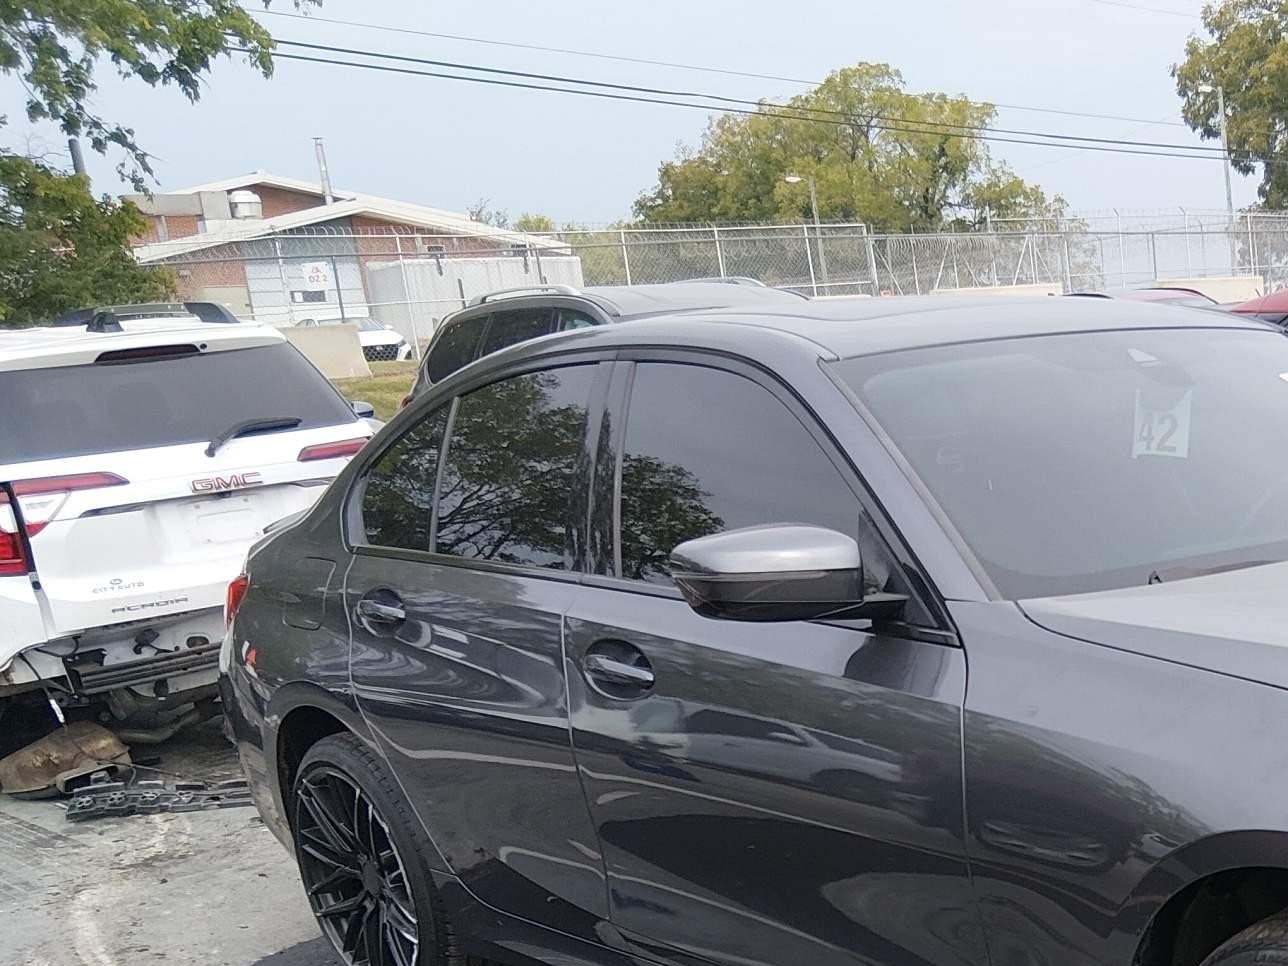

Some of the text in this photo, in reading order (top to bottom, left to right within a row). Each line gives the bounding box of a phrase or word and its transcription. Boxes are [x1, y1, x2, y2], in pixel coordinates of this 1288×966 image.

[1138, 413, 1178, 452] 42
[191, 472, 264, 494] GMC
[111, 597, 188, 613] ACADIA
